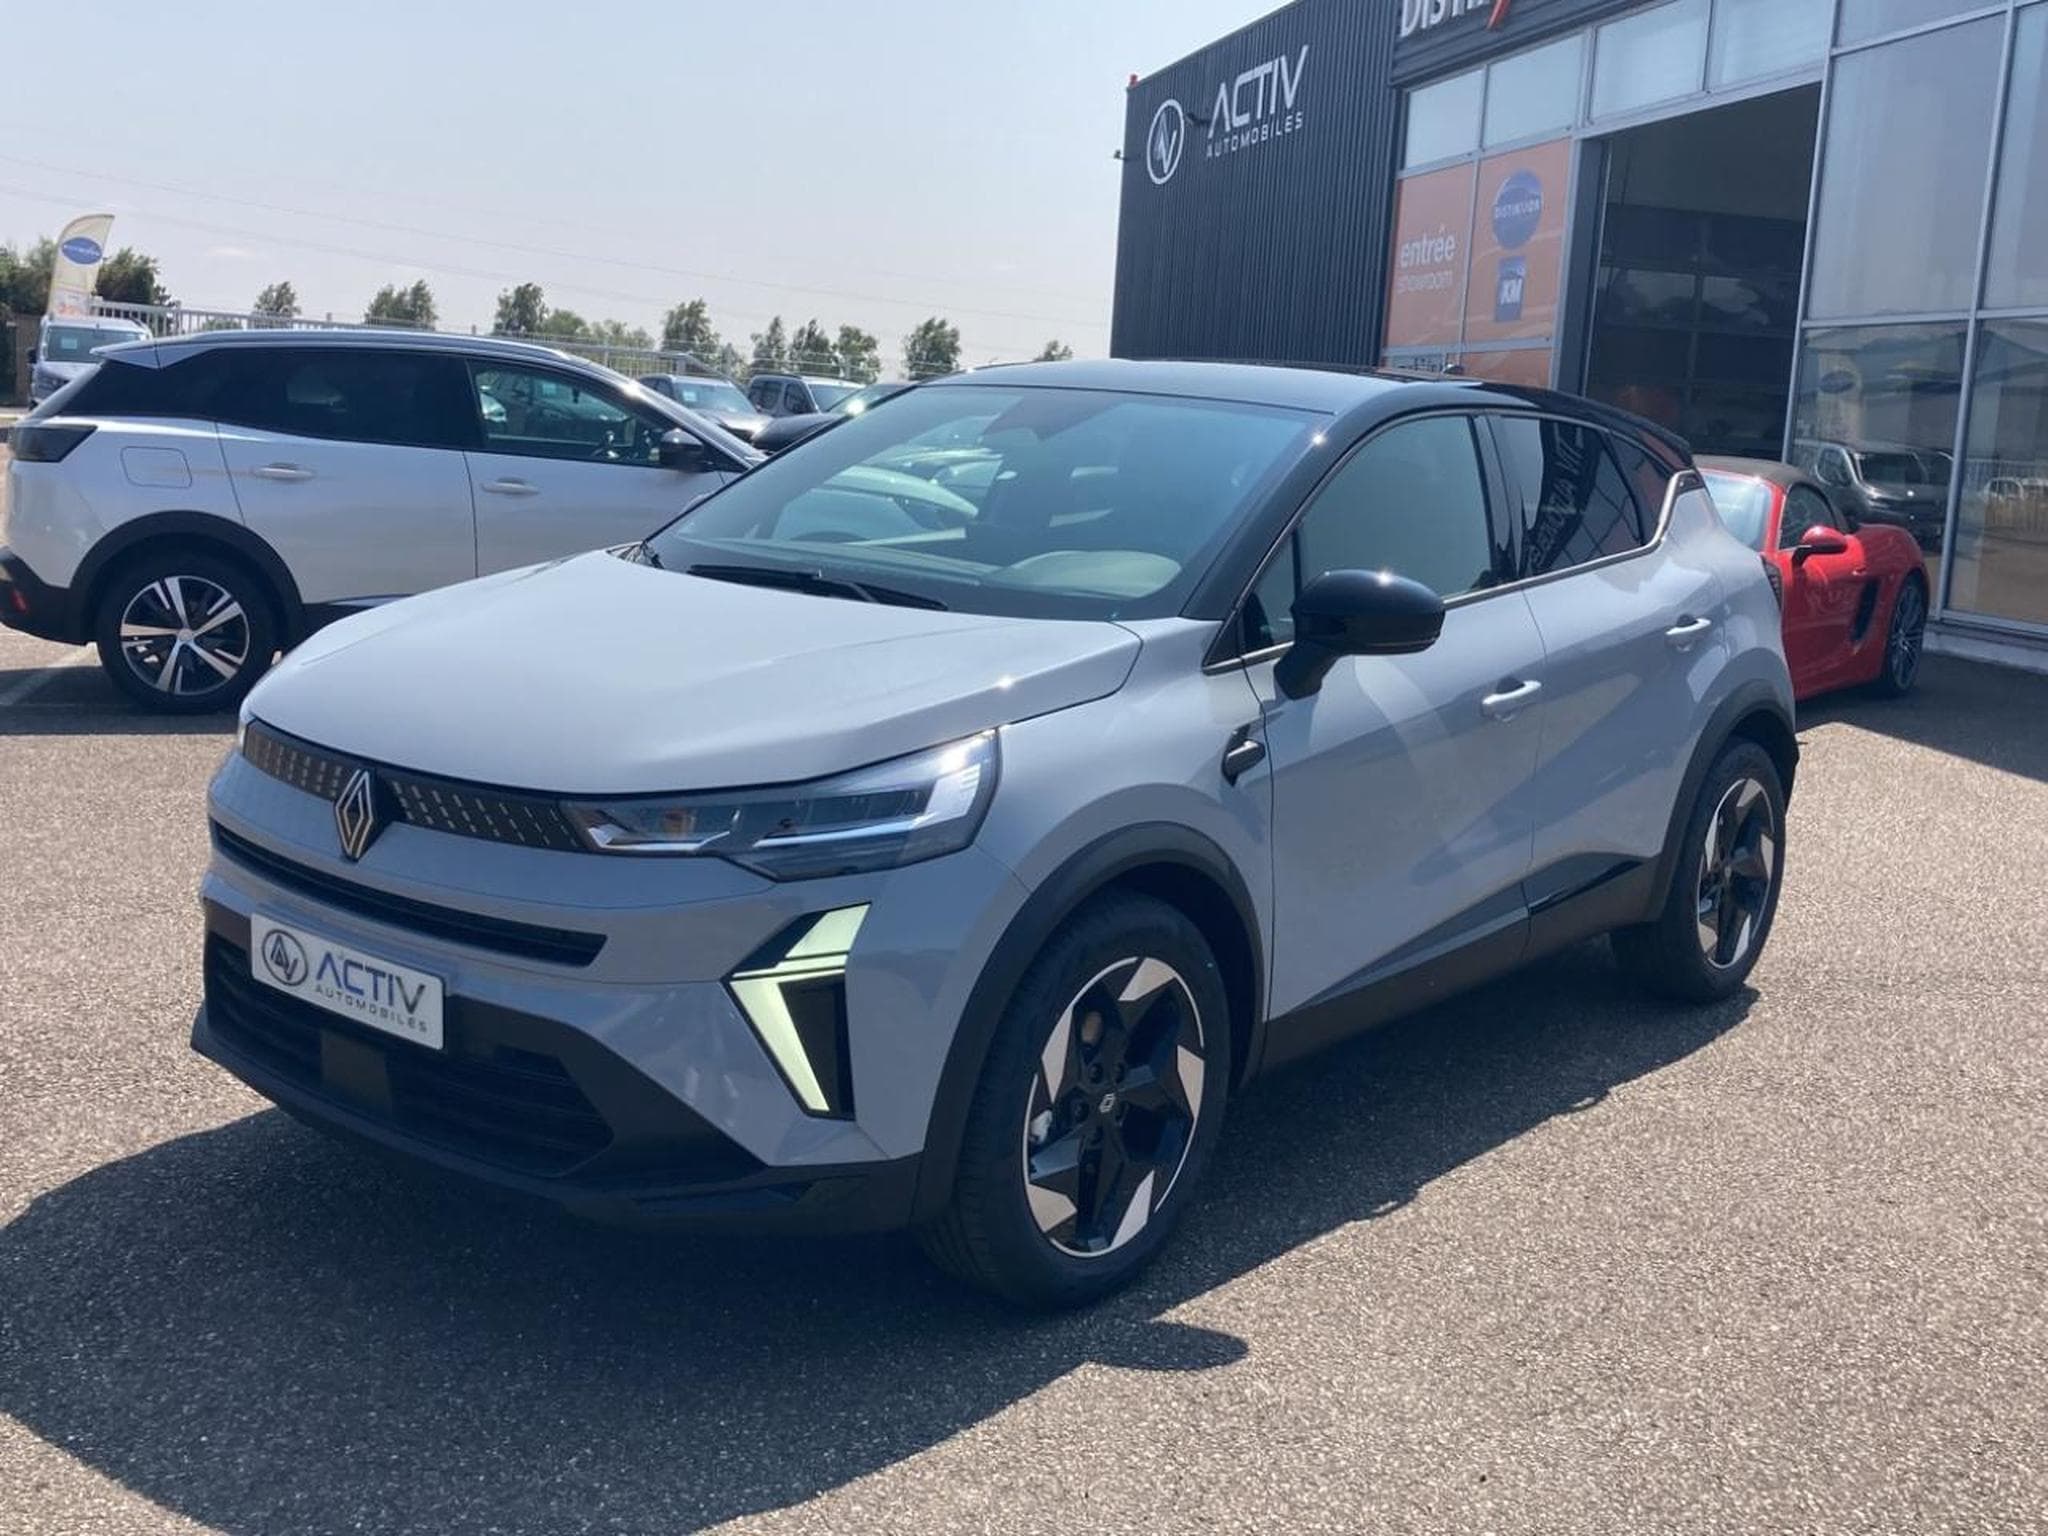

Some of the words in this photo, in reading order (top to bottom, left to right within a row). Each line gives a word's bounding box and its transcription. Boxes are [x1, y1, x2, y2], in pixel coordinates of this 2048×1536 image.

[1207, 45, 1309, 139] ACTIV
[1206, 111, 1304, 158] AUTOMOBILES
[314, 985, 428, 1033] AUTOMOBILES
[316, 952, 426, 1015] ACTIV
